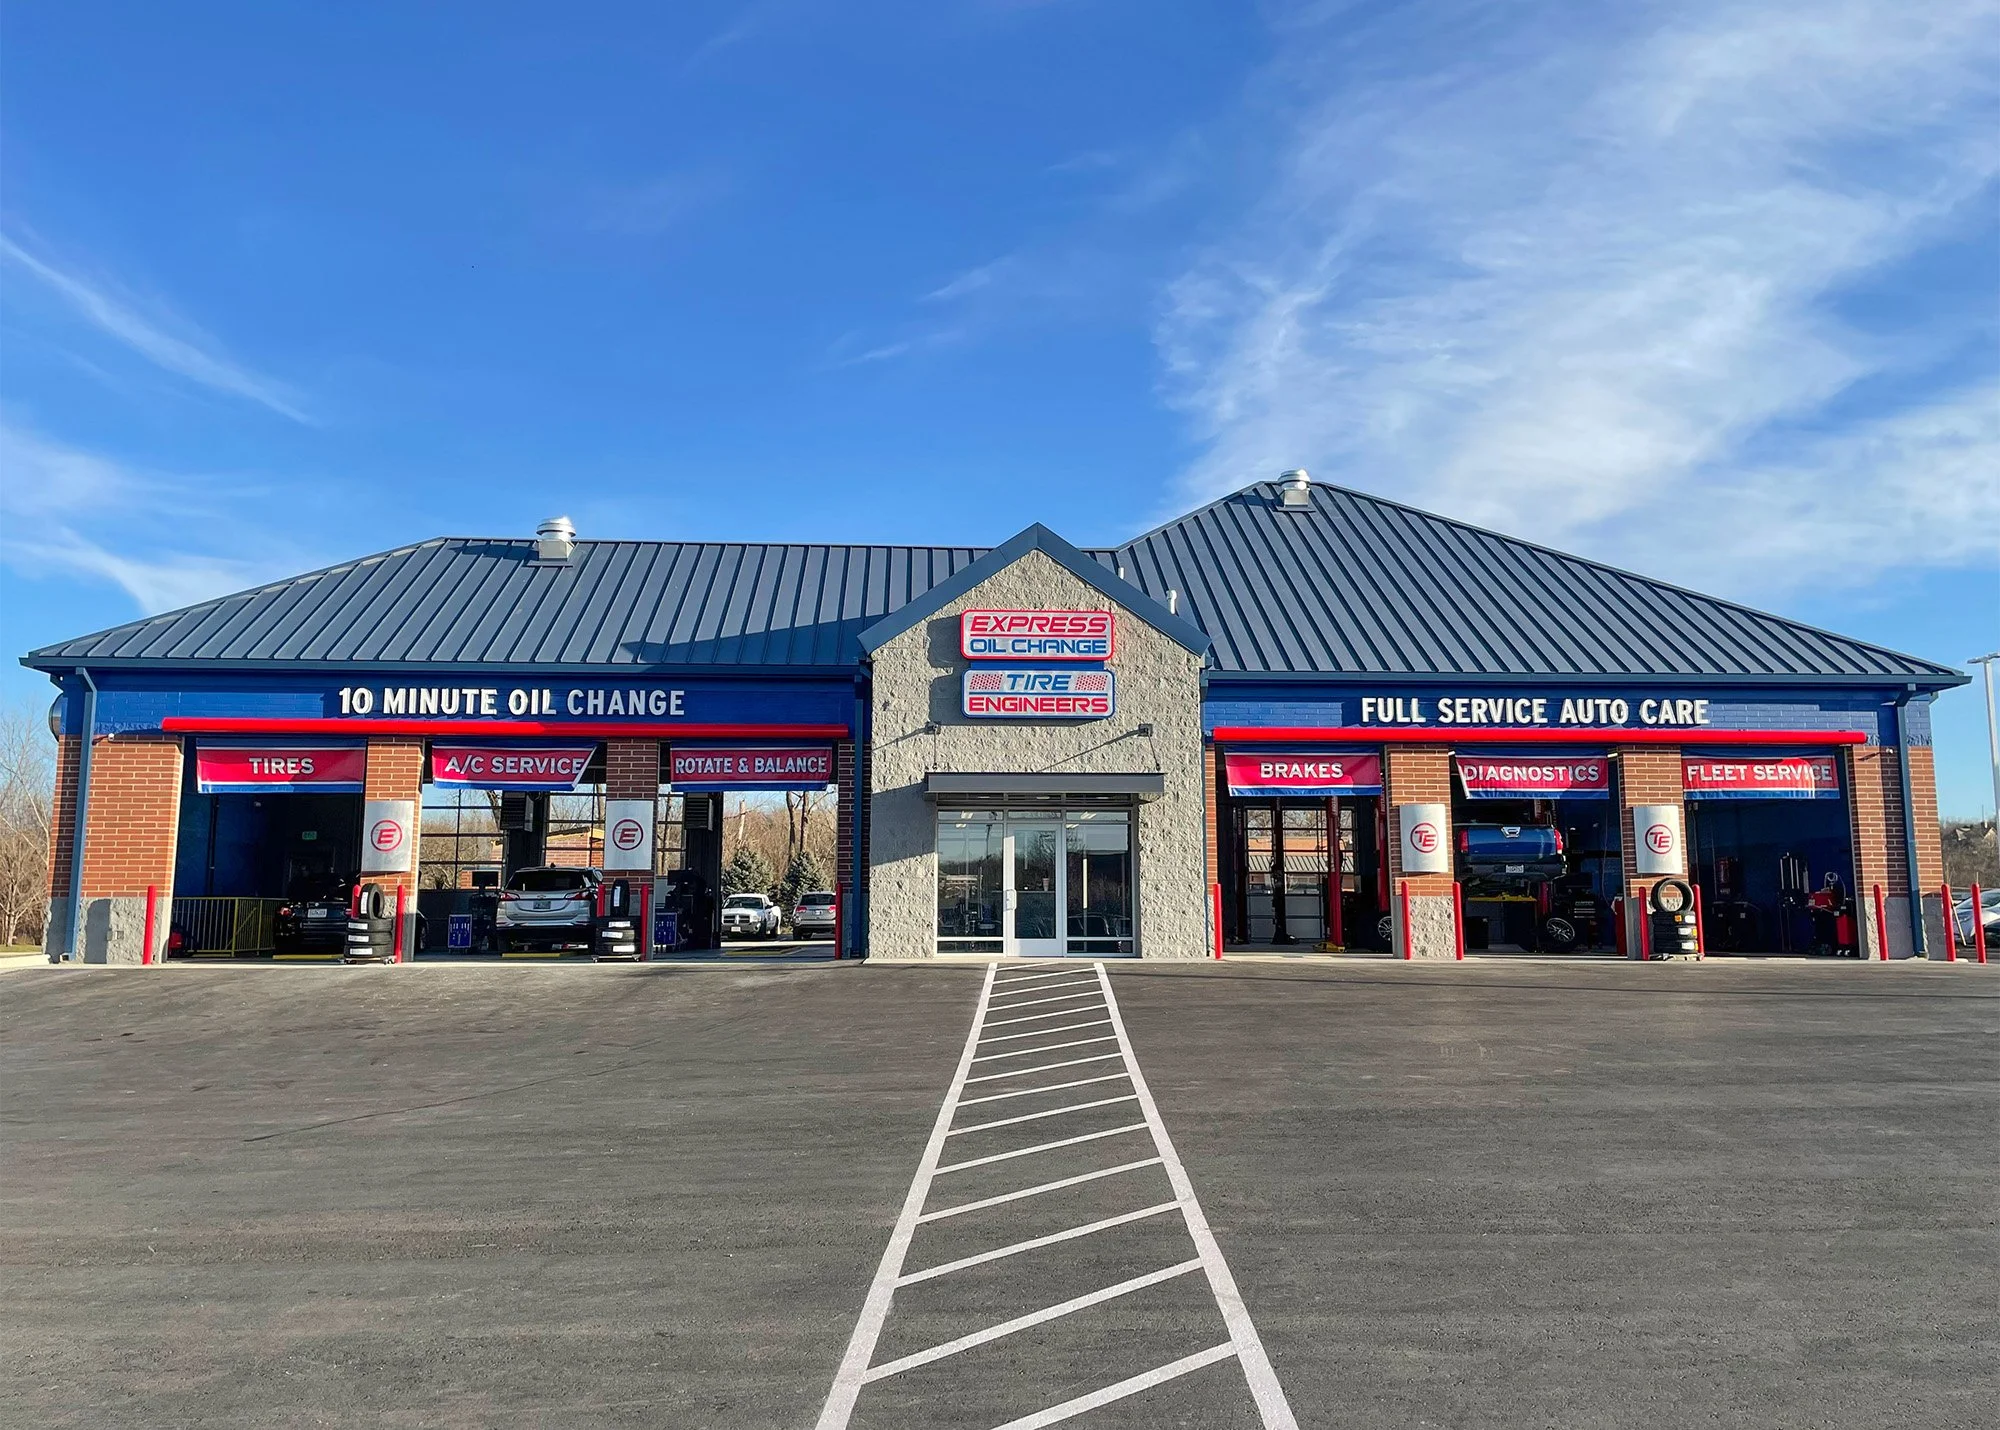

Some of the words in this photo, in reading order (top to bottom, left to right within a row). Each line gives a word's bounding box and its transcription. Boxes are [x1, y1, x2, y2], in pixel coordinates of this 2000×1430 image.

[970, 615, 1107, 633] EXPRESS
[970, 639, 1006, 653] OIL
[1011, 639, 1107, 653] CHANGE
[1007, 674, 1071, 690] TIRE
[339, 687, 373, 714] 10
[383, 687, 497, 715] MINUTE
[508, 688, 556, 715] OIL
[567, 689, 685, 715] CHANGE
[969, 697, 1108, 712] ENGINEERS
[1362, 697, 1426, 723] FULL
[1438, 697, 1548, 723] SERVICE
[1560, 698, 1629, 724] AUTO
[1639, 699, 1711, 724] CARE
[249, 757, 315, 775] TIRES
[444, 755, 484, 774] A/C
[491, 756, 585, 775] SERVICE
[675, 757, 733, 774] ROTATE
[738, 757, 749, 773] &
[755, 757, 827, 773] BALANCE
[1260, 763, 1344, 779] BRAKES
[1464, 764, 1599, 781] DIAGNOSTICS
[1687, 764, 1748, 782] FLEET
[1753, 764, 1833, 781] SERVICE
[377, 829, 397, 845] E
[619, 828, 638, 844] E
[1415, 830, 1437, 847] TE
[1650, 831, 1671, 848] TE
